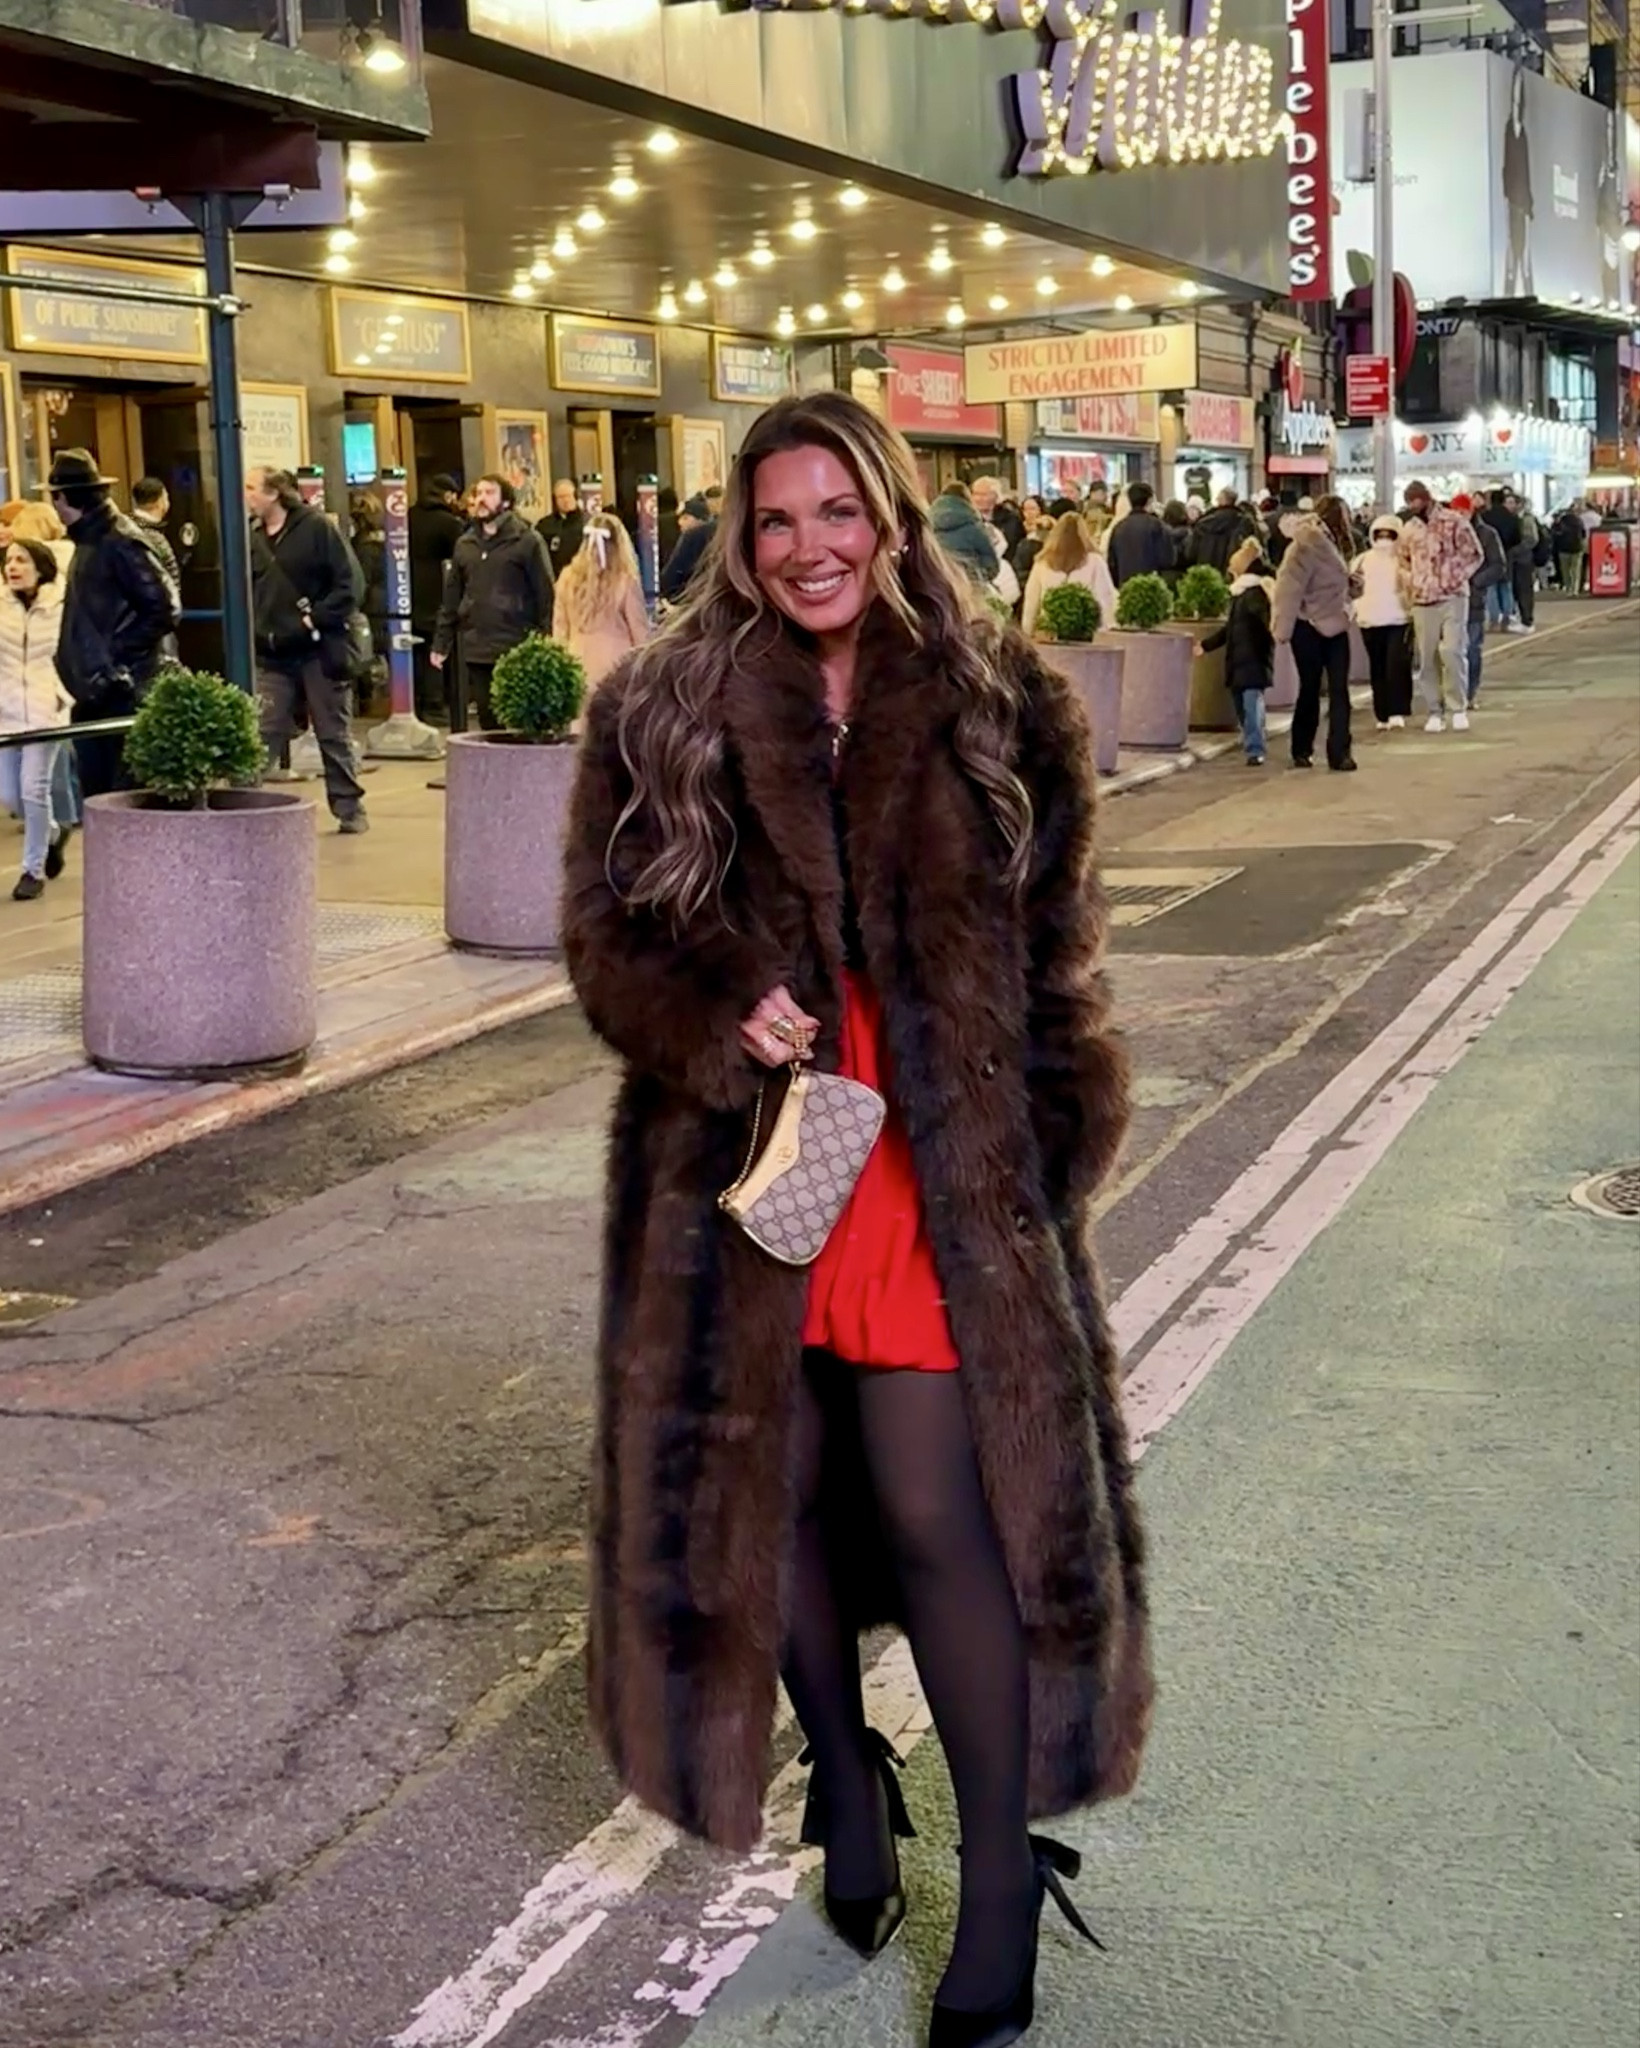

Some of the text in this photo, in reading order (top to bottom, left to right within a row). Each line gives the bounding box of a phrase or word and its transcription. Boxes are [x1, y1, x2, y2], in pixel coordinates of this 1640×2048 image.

[36, 298, 55, 325] OF
[60, 301, 99, 330] PURE
[988, 332, 1168, 371] STRICTLY LIMITED
[1008, 363, 1146, 396] ENGAGEMENT
[1430, 433, 1467, 453] NY
[1485, 446, 1513, 462] NY
